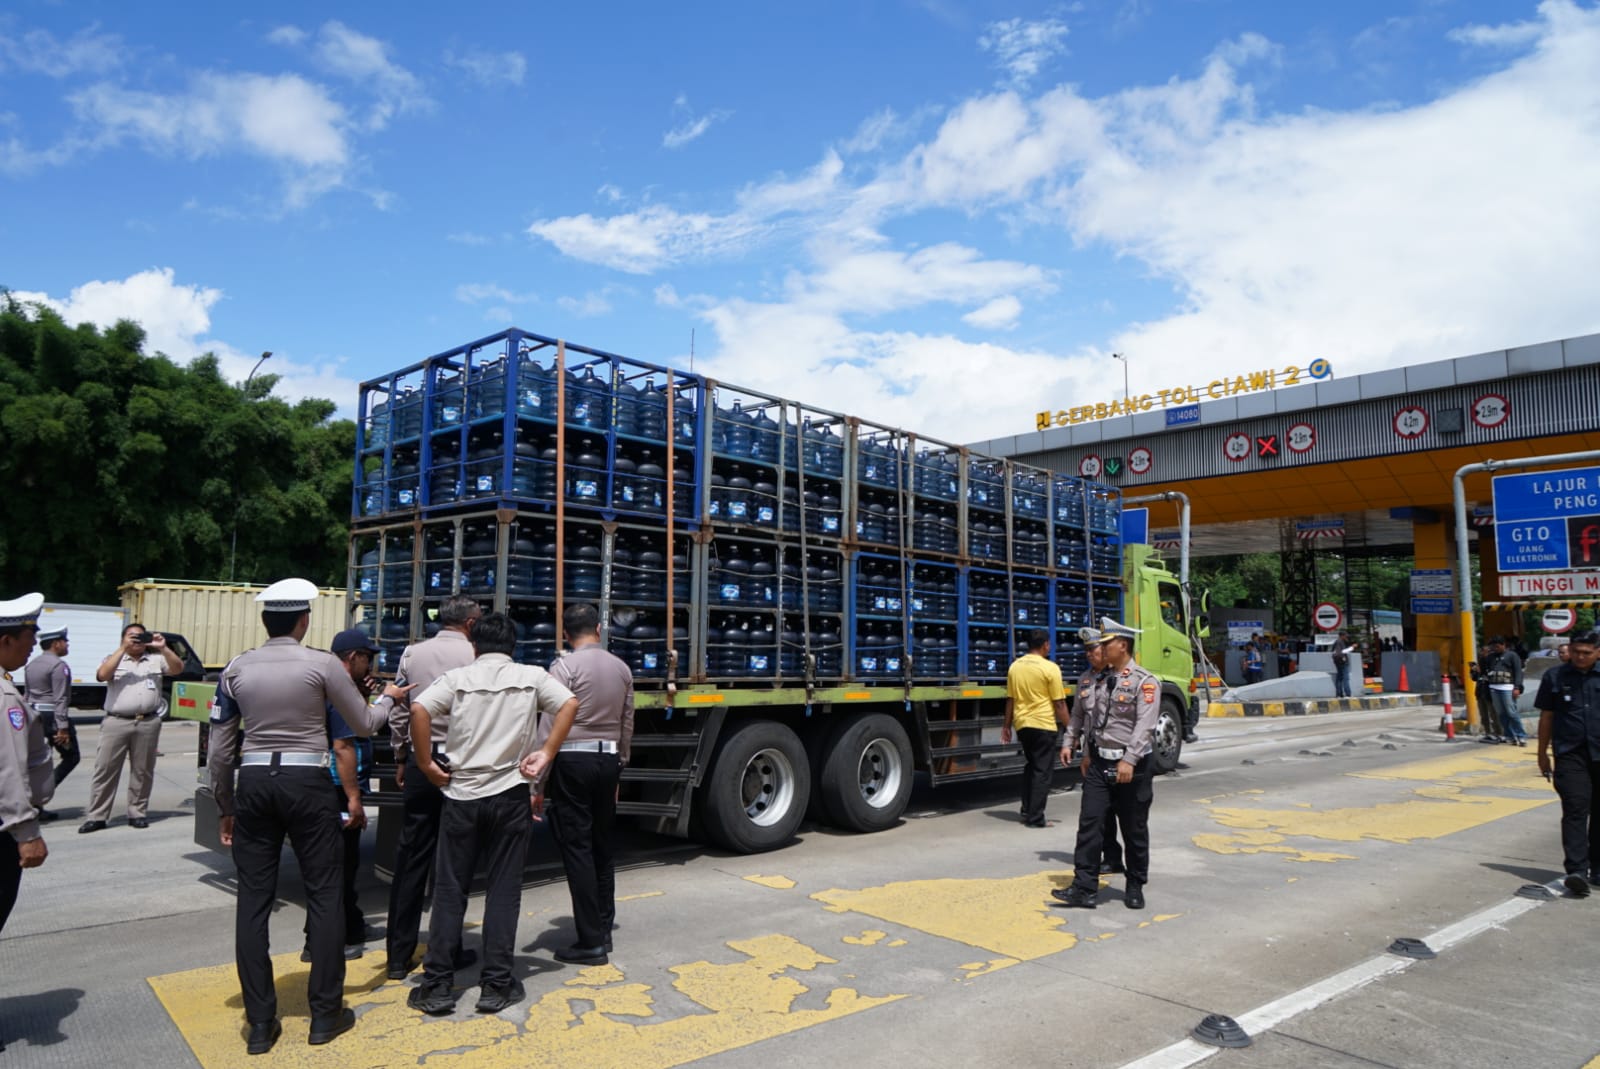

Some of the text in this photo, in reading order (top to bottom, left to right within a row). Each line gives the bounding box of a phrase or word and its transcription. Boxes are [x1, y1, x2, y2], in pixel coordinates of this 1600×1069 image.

[1056, 365, 1300, 426] GERBANG TOL CIAWI 2
[1533, 477, 1586, 494] LAJUR
[1554, 494, 1597, 510] PENG
[1511, 526, 1550, 542] GTO
[1519, 545, 1544, 553] UANG
[1507, 554, 1557, 563] ELEKTRONIK
[1518, 578, 1574, 592] TINGGI
